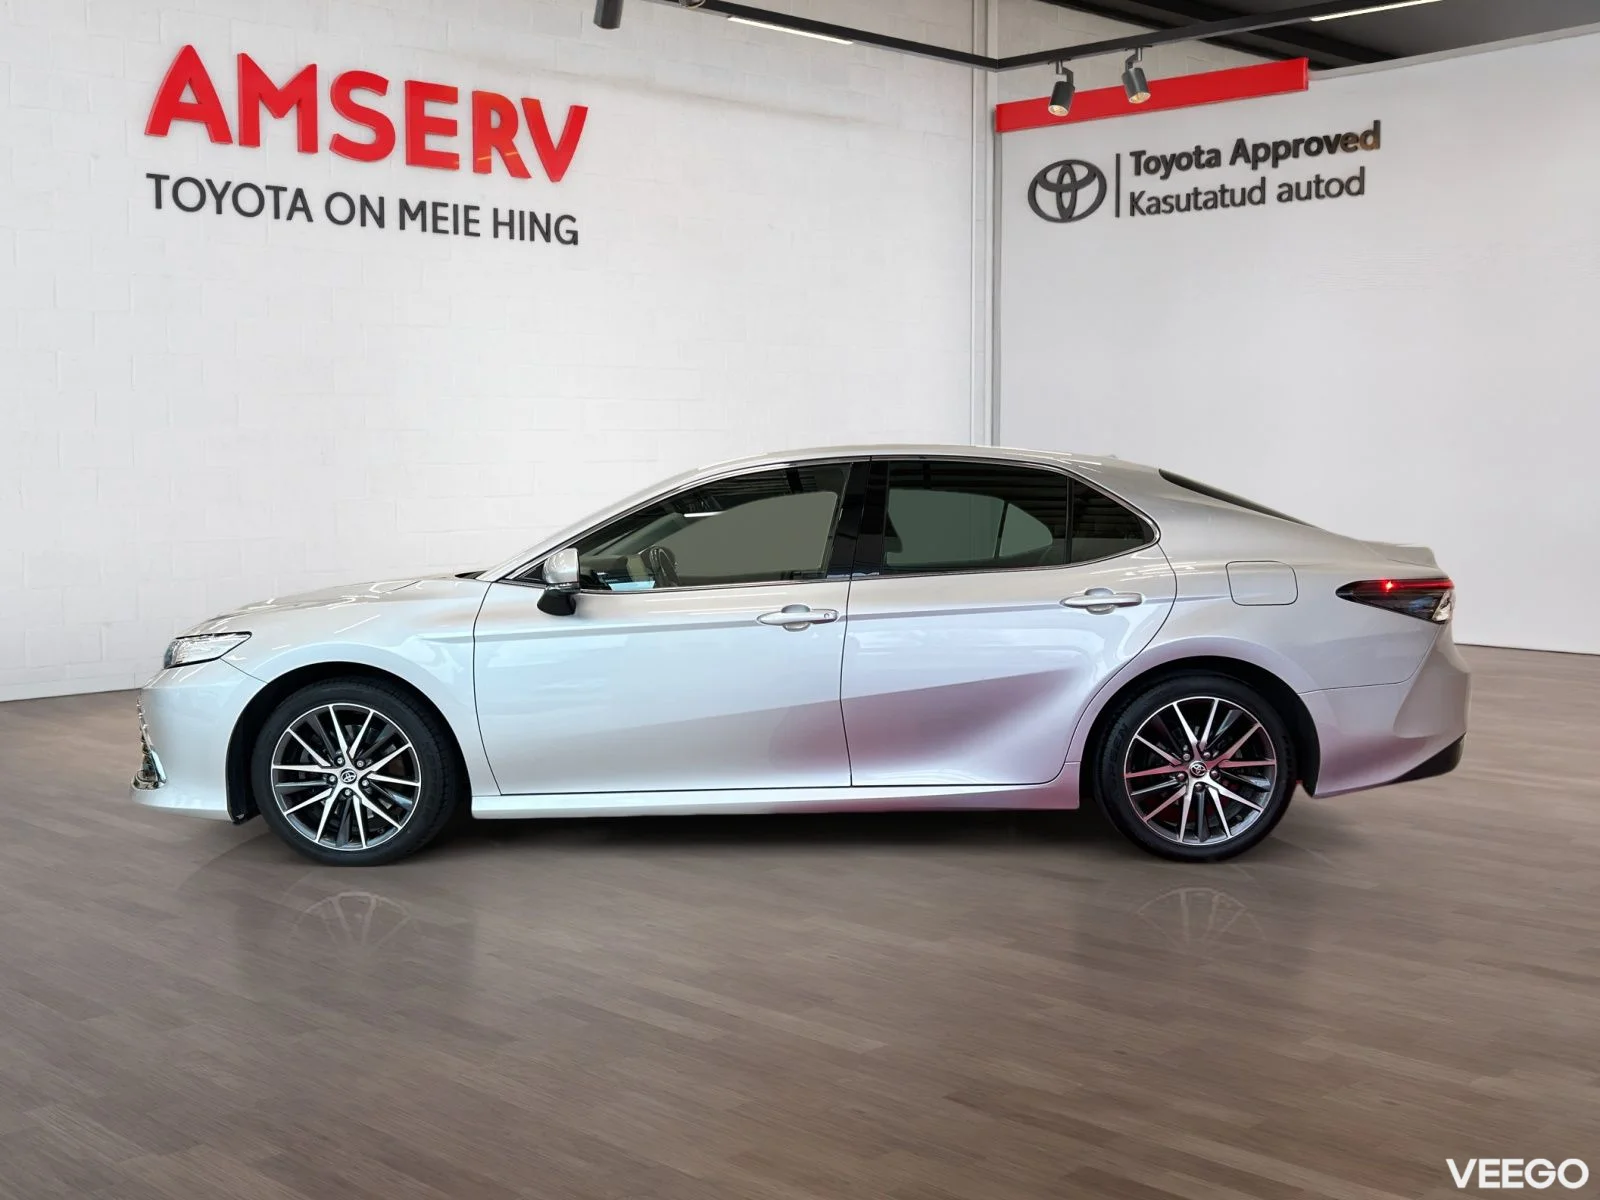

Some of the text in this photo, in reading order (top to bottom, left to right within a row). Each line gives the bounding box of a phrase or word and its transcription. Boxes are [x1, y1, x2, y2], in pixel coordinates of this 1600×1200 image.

[143, 44, 590, 183] AMSERV
[1129, 119, 1382, 180] Toyota Approved
[145, 173, 579, 246] TOYOTA ON MEIE HING
[1129, 166, 1366, 217] Kasutatud autod
